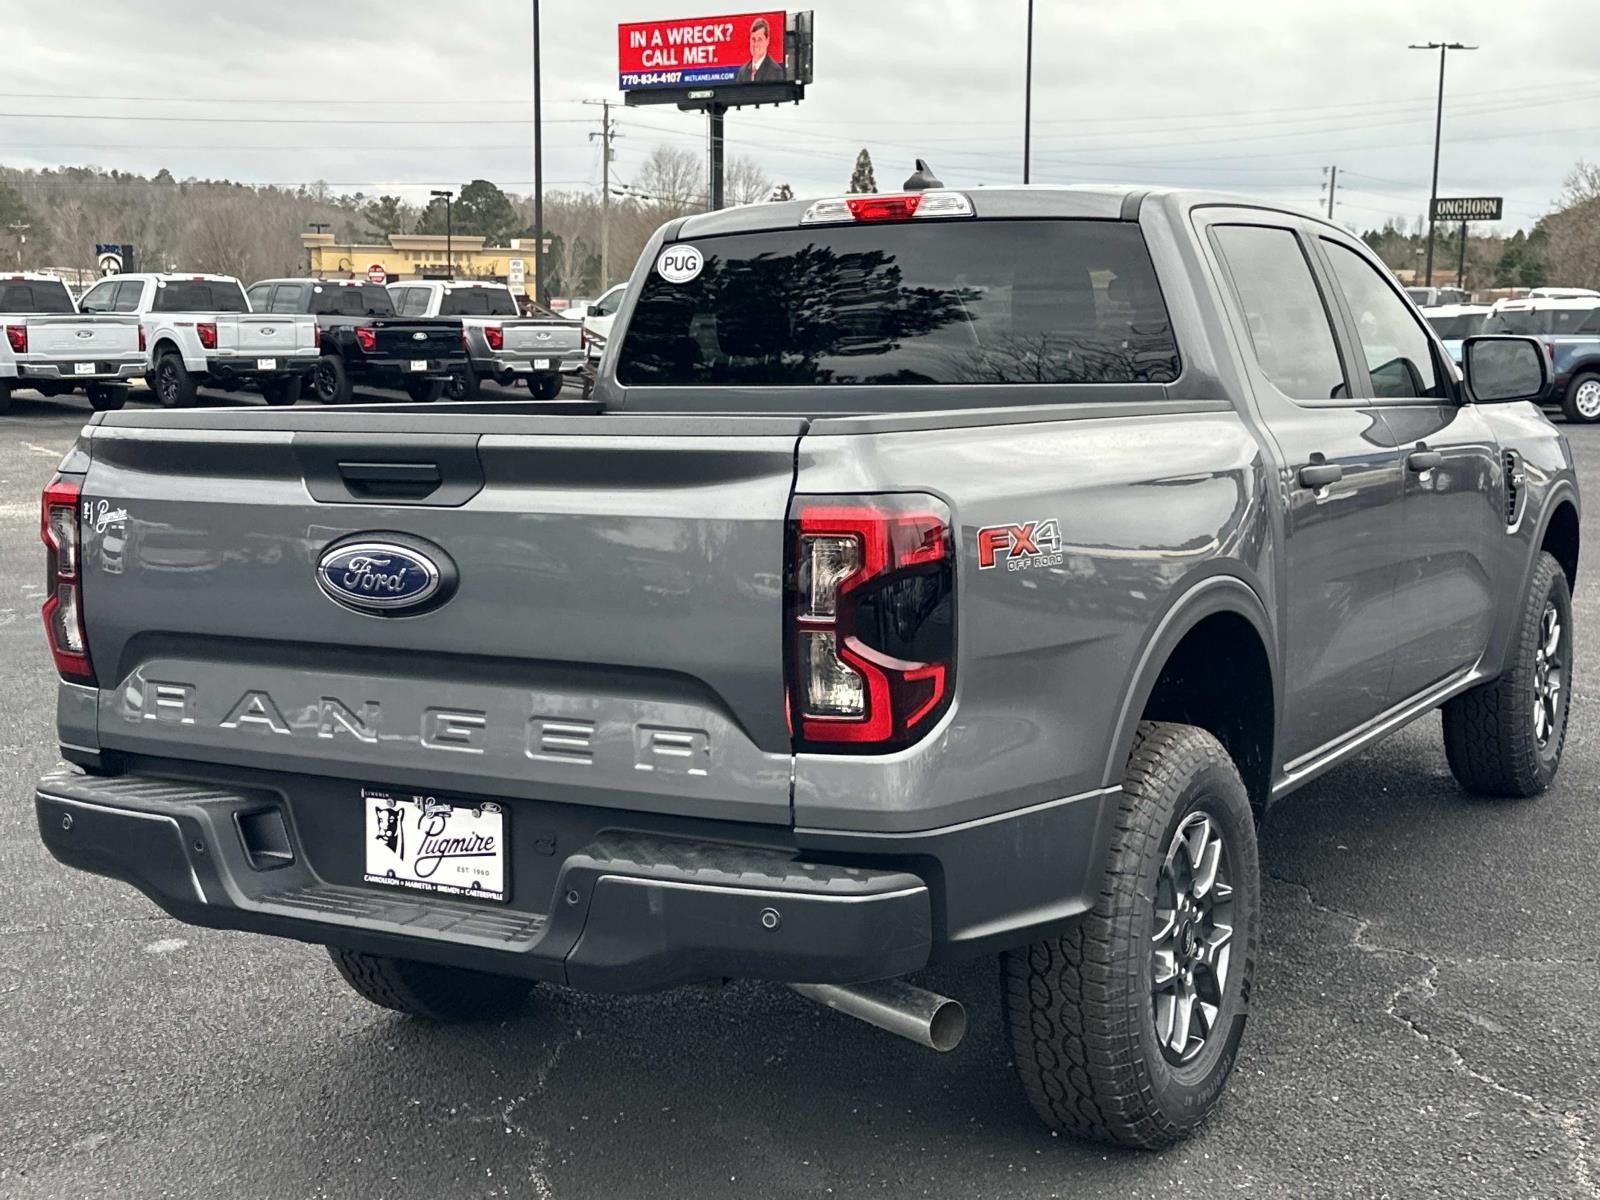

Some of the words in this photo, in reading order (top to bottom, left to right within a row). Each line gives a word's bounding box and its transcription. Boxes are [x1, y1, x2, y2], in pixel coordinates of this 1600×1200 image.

[630, 31, 646, 48] IN
[651, 29, 663, 45] A
[666, 23, 734, 44] WRECK?
[642, 49, 678, 67] CALL
[683, 46, 719, 65] MET.
[622, 72, 682, 85] 770-834-4107
[1436, 199, 1497, 214] ONGHORN
[664, 255, 697, 271] PUG
[977, 518, 1063, 570] FX4
[1007, 558, 1031, 571] OFF
[1033, 554, 1063, 567] ROAD
[343, 556, 407, 593] Ford
[142, 680, 711, 776] RANGER
[414, 812, 497, 878] Pugmire
